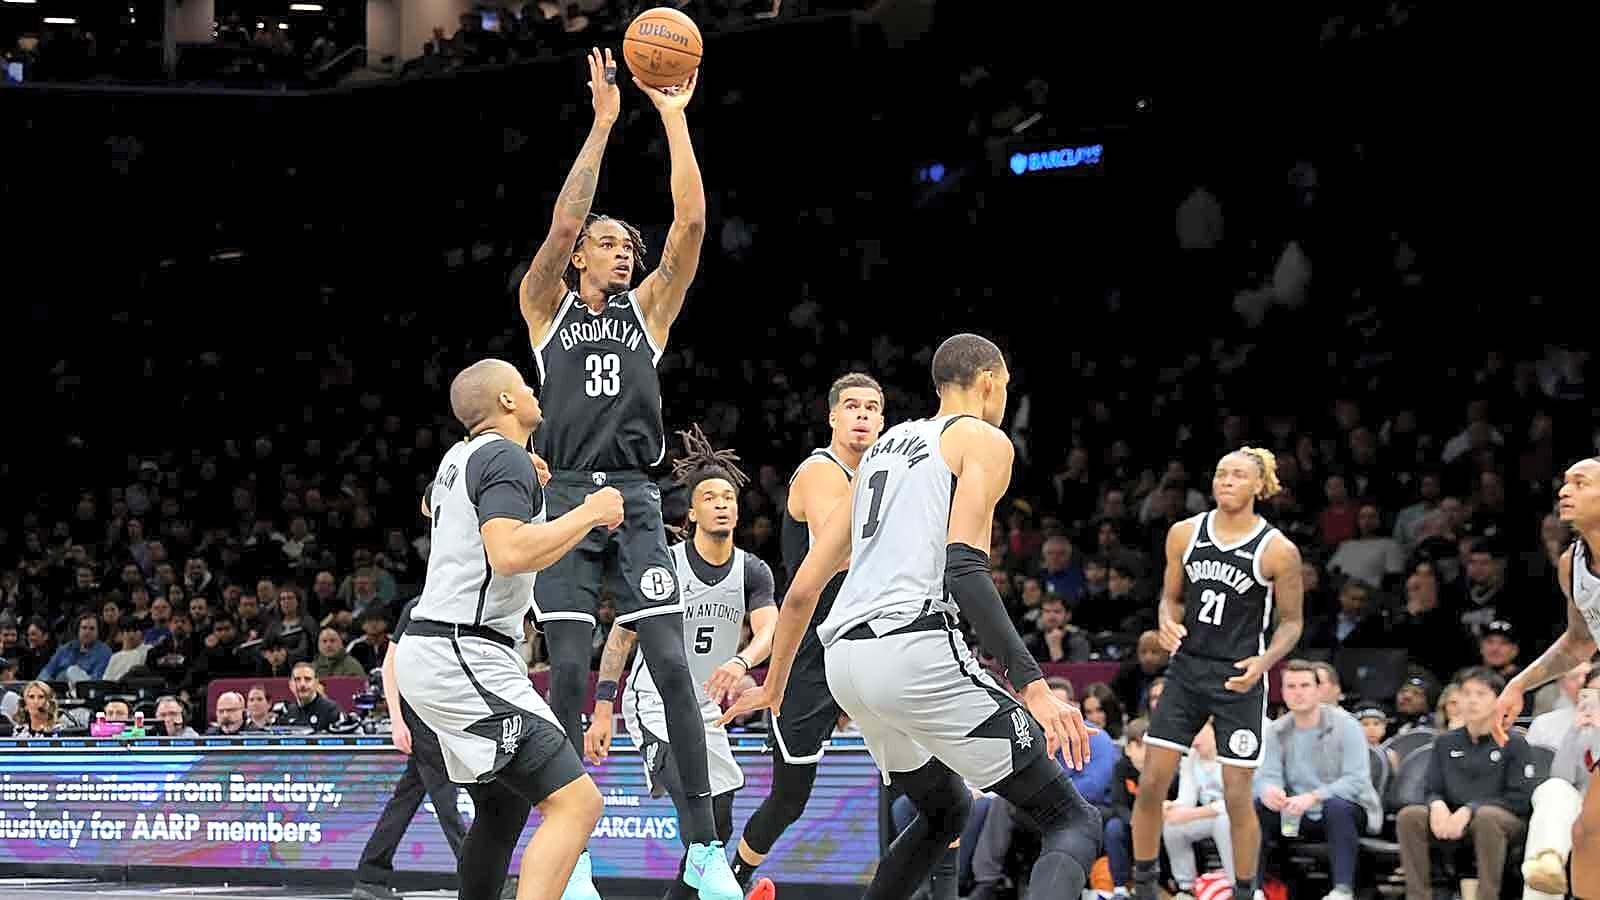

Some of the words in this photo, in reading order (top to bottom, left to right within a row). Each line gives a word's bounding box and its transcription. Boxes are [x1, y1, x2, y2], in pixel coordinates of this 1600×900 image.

[639, 23, 689, 47] Wilson
[559, 317, 643, 351] BROOKLYN
[585, 353, 621, 397] 33
[861, 470, 889, 539] 1
[1184, 559, 1255, 595] BROOKLYN
[697, 603, 740, 624] ANTONIO
[1198, 589, 1226, 626] 21
[694, 626, 715, 655] 5
[0, 774, 49, 809] ings
[55, 774, 159, 801] solutions
[164, 773, 223, 801] from
[229, 773, 343, 811] Barclays,
[90, 811, 126, 839] for
[132, 812, 200, 840] AARP
[207, 812, 322, 842] members
